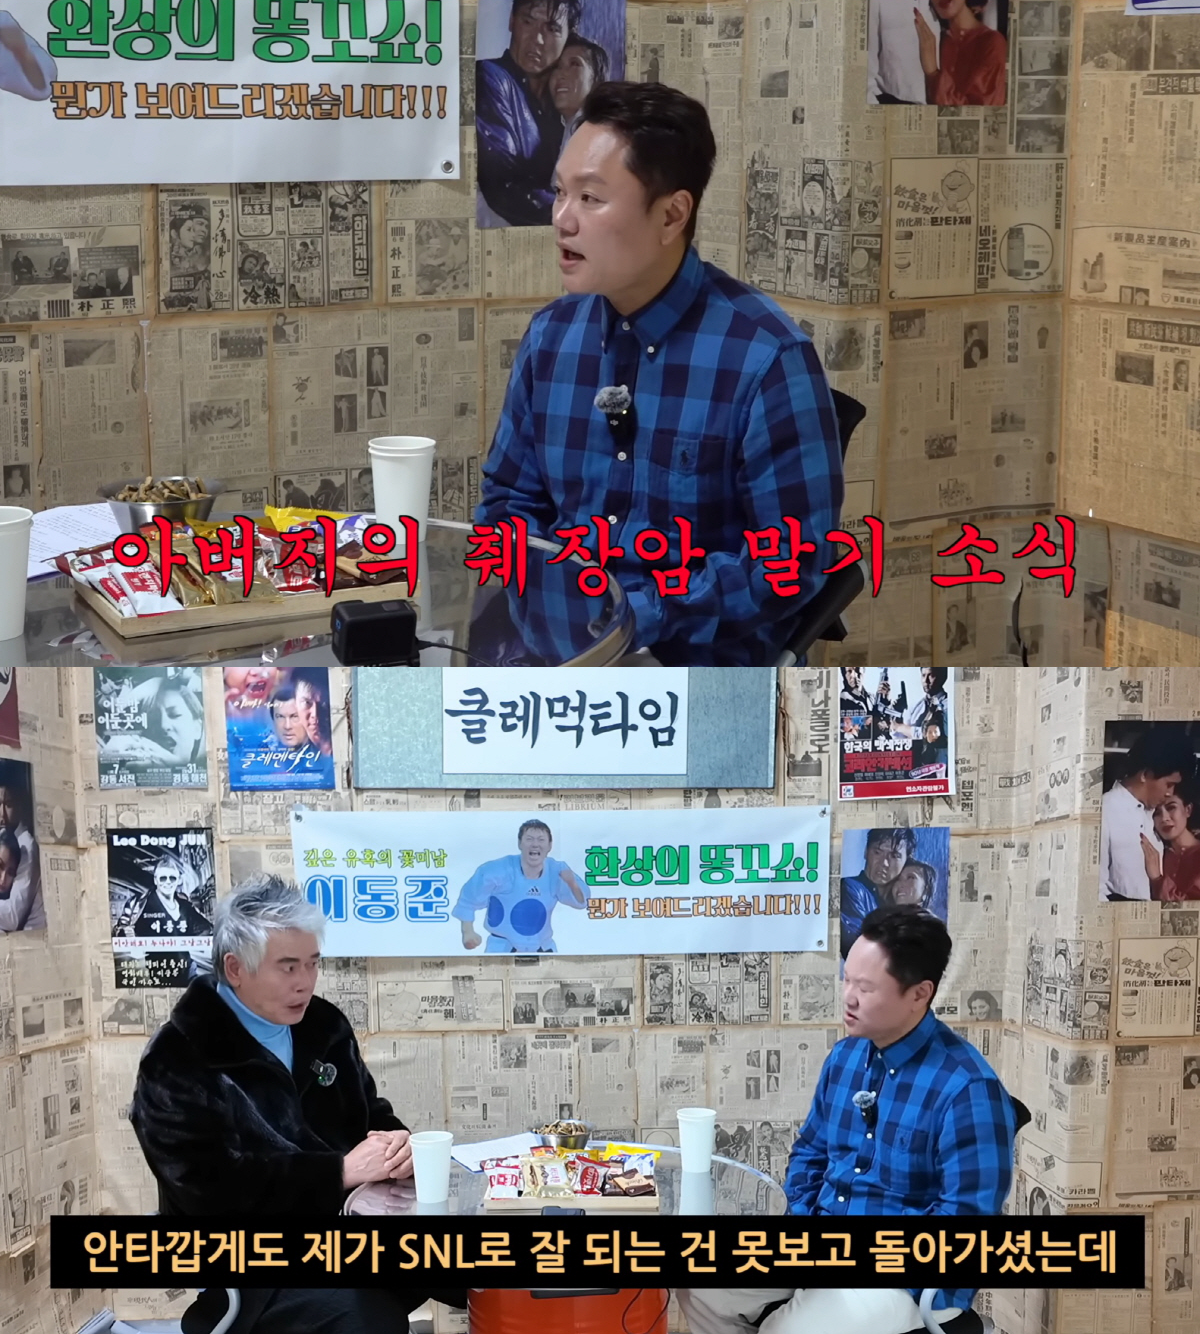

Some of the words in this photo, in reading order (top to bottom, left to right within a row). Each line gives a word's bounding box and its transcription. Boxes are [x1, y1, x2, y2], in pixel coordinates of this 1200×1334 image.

[47, 0, 235, 62] 환상의
[50, 81, 127, 119] 뭔가
[135, 82, 448, 119] 보여드리겠습니다!!!
[930, 215, 972, 227] 판타제
[444, 686, 678, 751] 클레먹타임
[843, 739, 871, 752] 한국의
[240, 744, 320, 773] 클레멘타인
[140, 834, 176, 848] Dong
[179, 833, 207, 846] JUN
[303, 849, 335, 867] 깊은
[342, 849, 392, 868] 유혹의
[398, 849, 447, 868] 꽃미남
[584, 845, 689, 886] 환상의
[698, 841, 818, 884] 똥꼬쇼!
[586, 897, 628, 919] 뭔가
